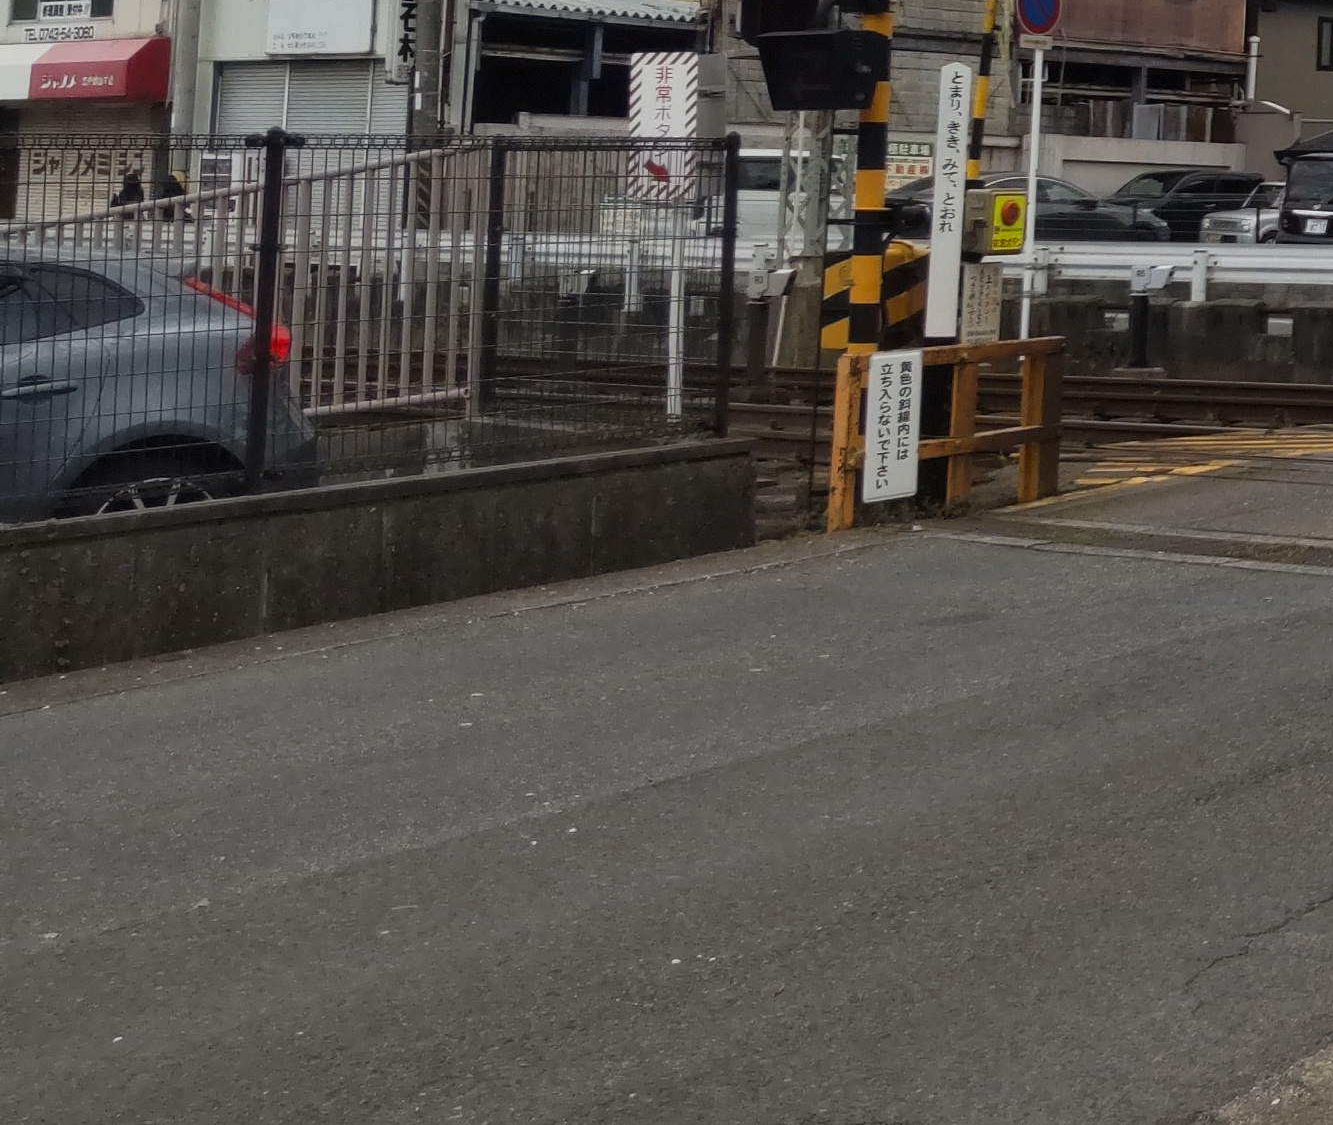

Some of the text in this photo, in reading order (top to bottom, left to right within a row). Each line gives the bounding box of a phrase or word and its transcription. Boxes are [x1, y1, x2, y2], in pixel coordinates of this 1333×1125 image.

[25, 29, 37, 41] TEL
[876, 363, 894, 489] 立ち入らないで下さい
[897, 361, 913, 460] 黄色の斜線内には
